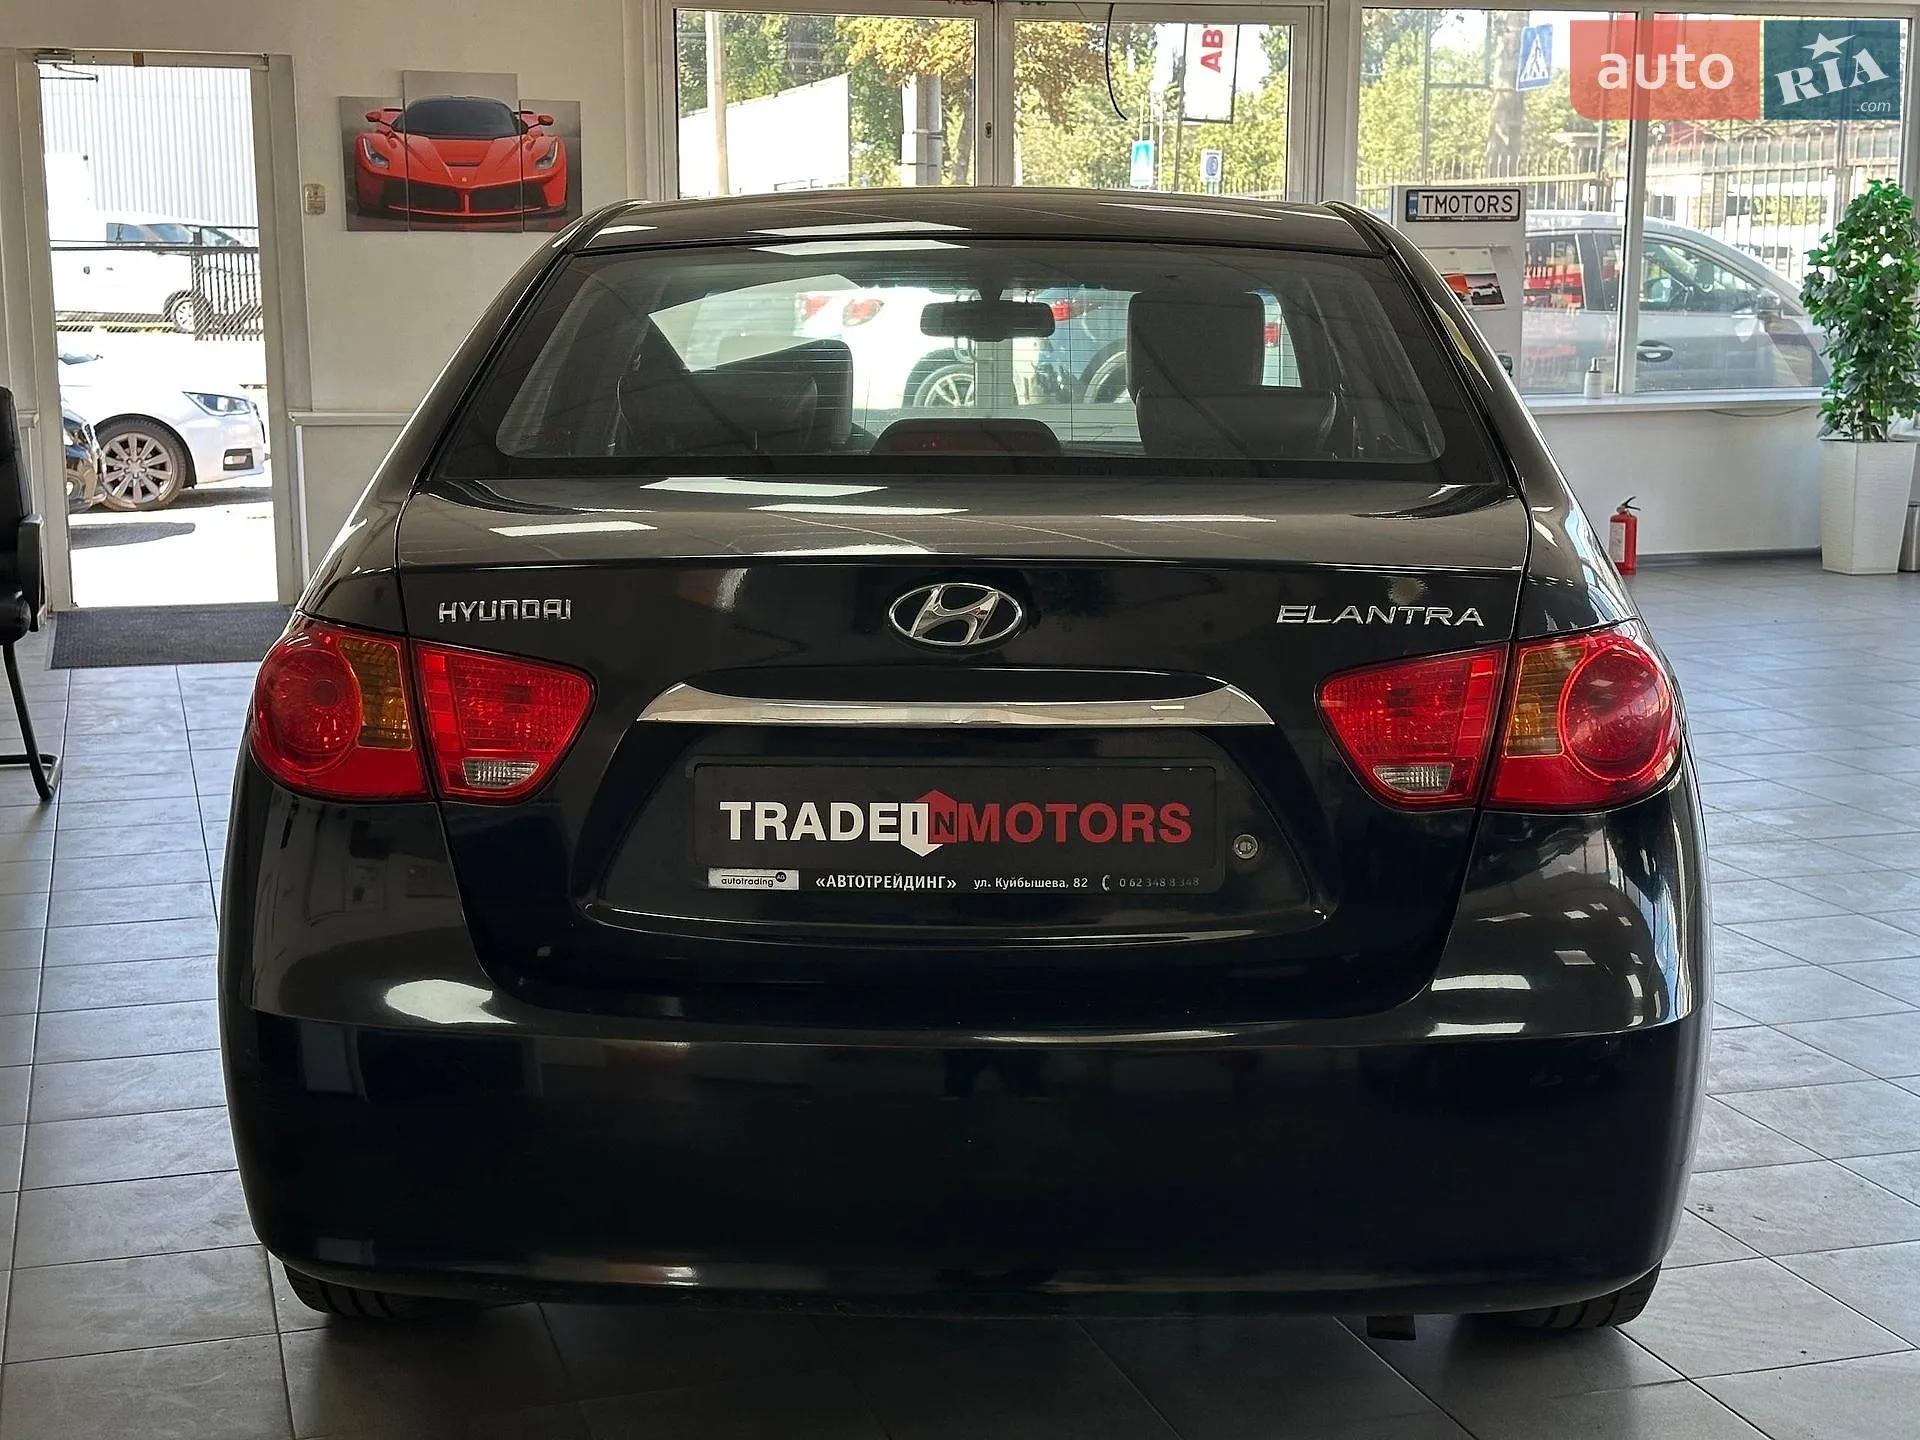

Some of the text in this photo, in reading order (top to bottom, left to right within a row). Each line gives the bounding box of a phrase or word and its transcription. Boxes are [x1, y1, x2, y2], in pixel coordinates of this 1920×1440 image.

[1422, 195, 1513, 214] TMOTORS
[438, 599, 572, 623] HYUNDAI
[1276, 604, 1485, 627] ELANTRA
[719, 801, 899, 841] TRADE
[957, 801, 1192, 843] MOTORS
[721, 876, 774, 888] autotrading
[815, 872, 957, 892] «АВТОТРЕЙДИНГ»
[973, 876, 991, 889] ул.
[995, 874, 1069, 889] Куйбышева,
[1073, 877, 1089, 889] 82
